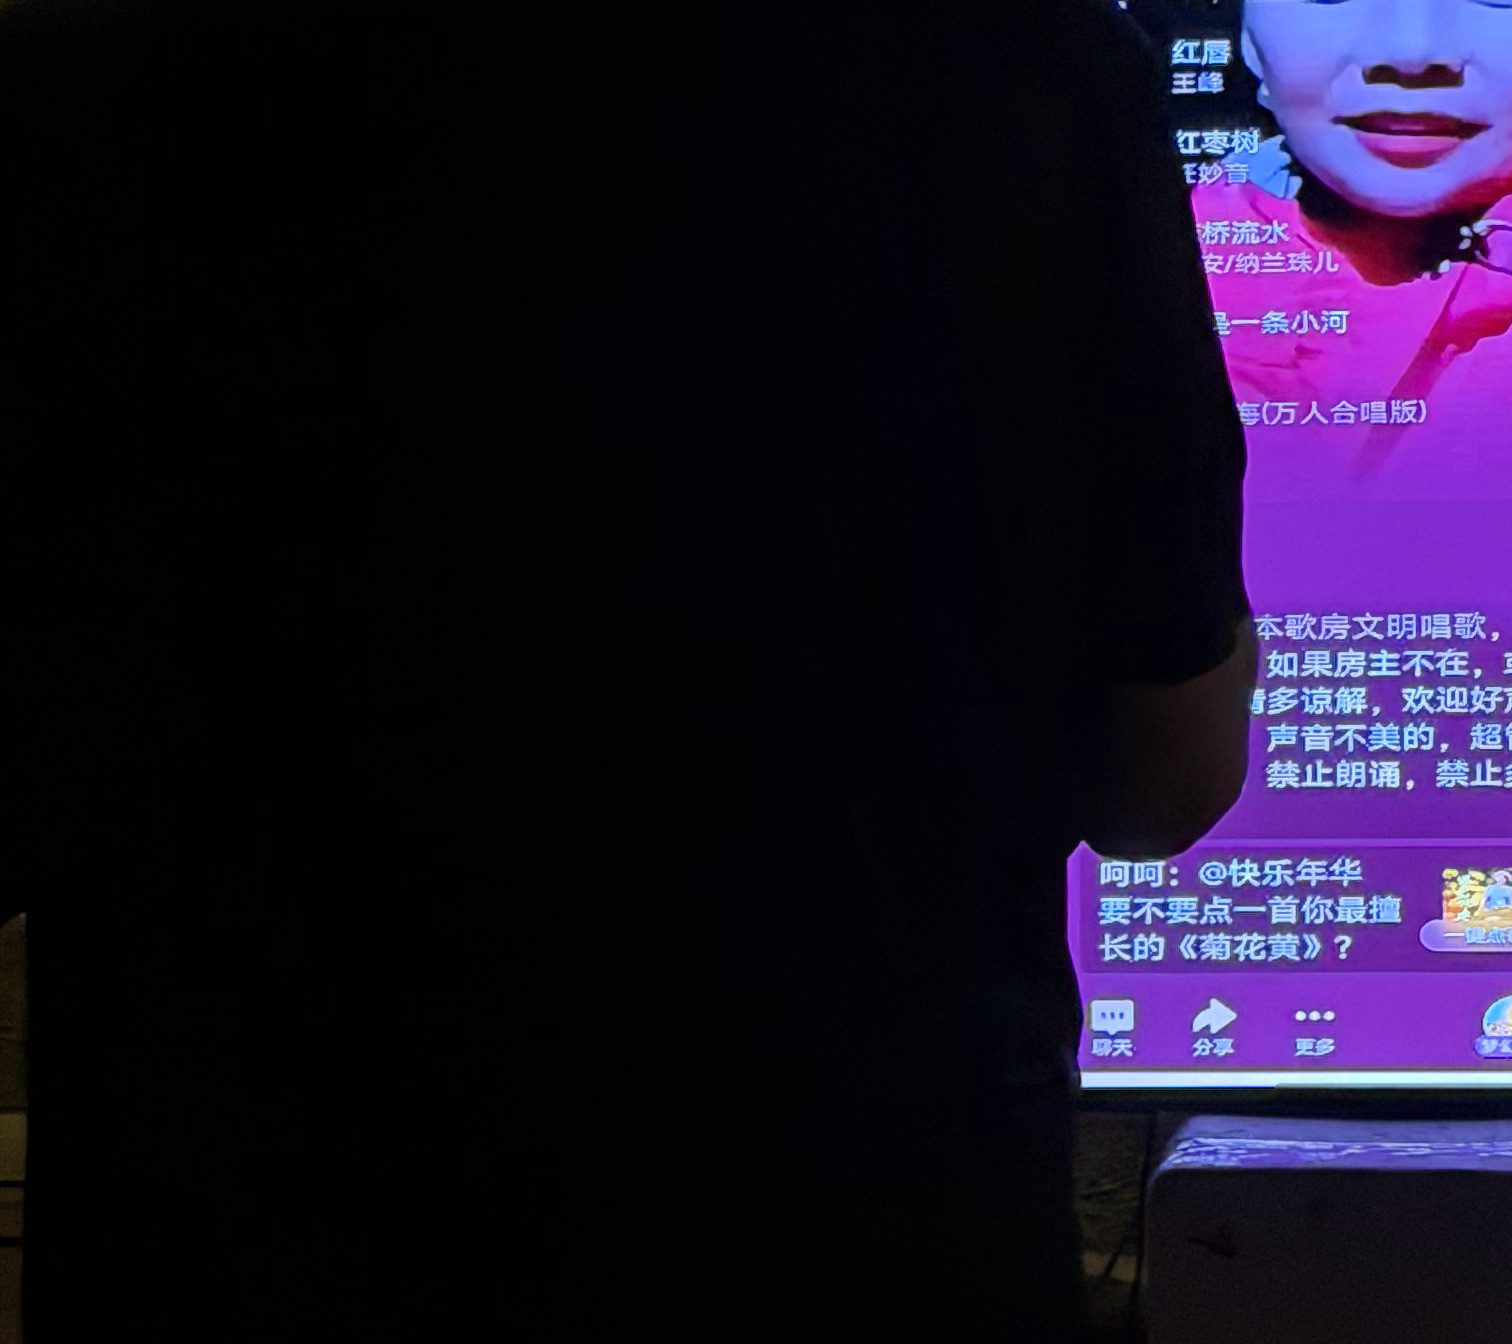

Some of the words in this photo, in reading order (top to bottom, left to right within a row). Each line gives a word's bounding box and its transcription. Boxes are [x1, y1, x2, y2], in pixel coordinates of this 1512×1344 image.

[1171, 39, 1231, 65] 红唇
[1196, 219, 1289, 244] 桥流水
[1099, 895, 1402, 925] 要不要点一首你最擅
[1192, 1038, 1235, 1057] 分享
[1295, 1038, 1335, 1057] 更多
